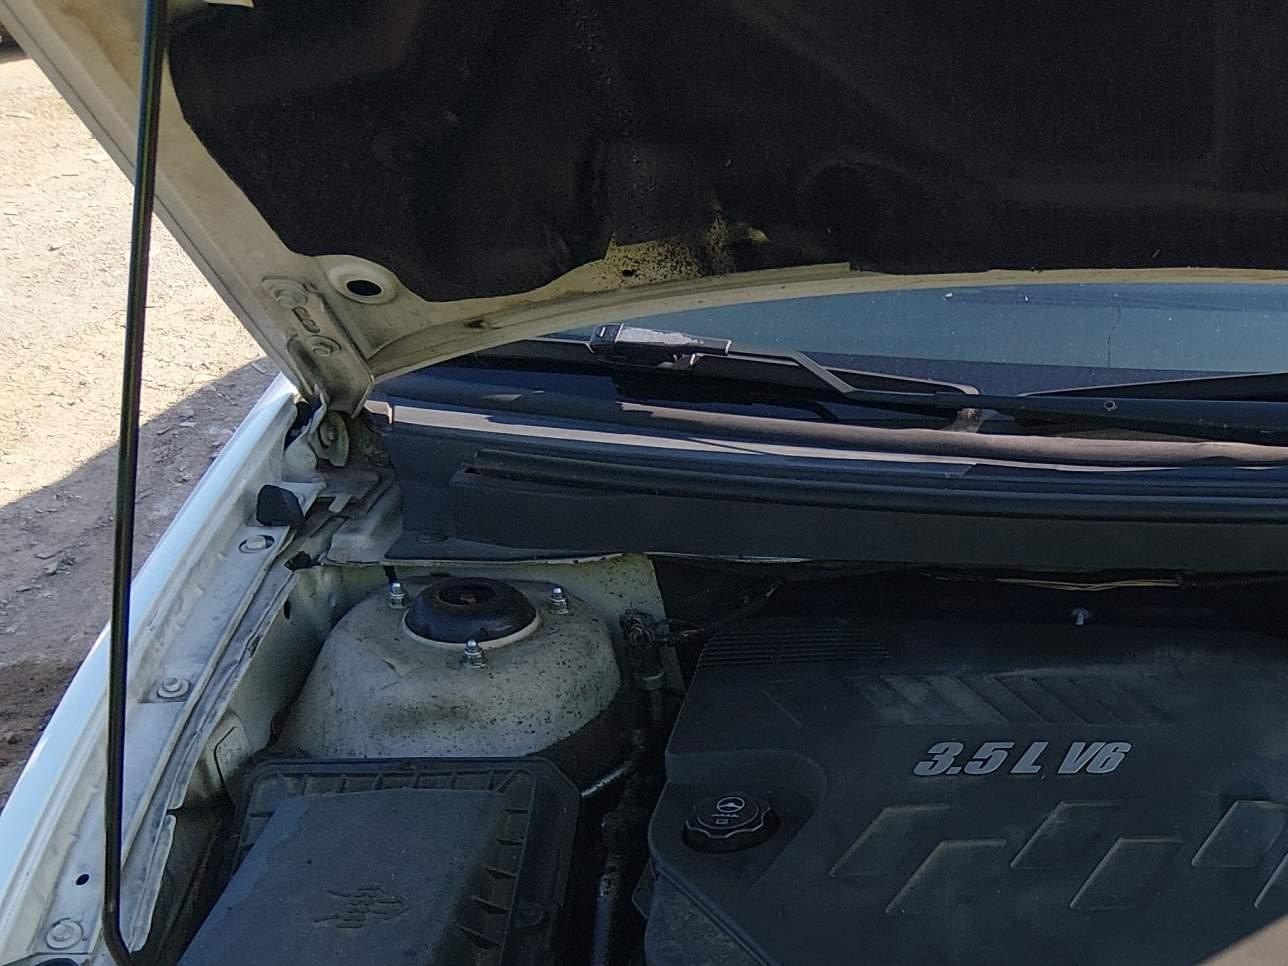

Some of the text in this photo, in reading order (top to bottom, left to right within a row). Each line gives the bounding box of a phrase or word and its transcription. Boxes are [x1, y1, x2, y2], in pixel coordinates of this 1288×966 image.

[913, 741, 1132, 776] 3.5 L V6
